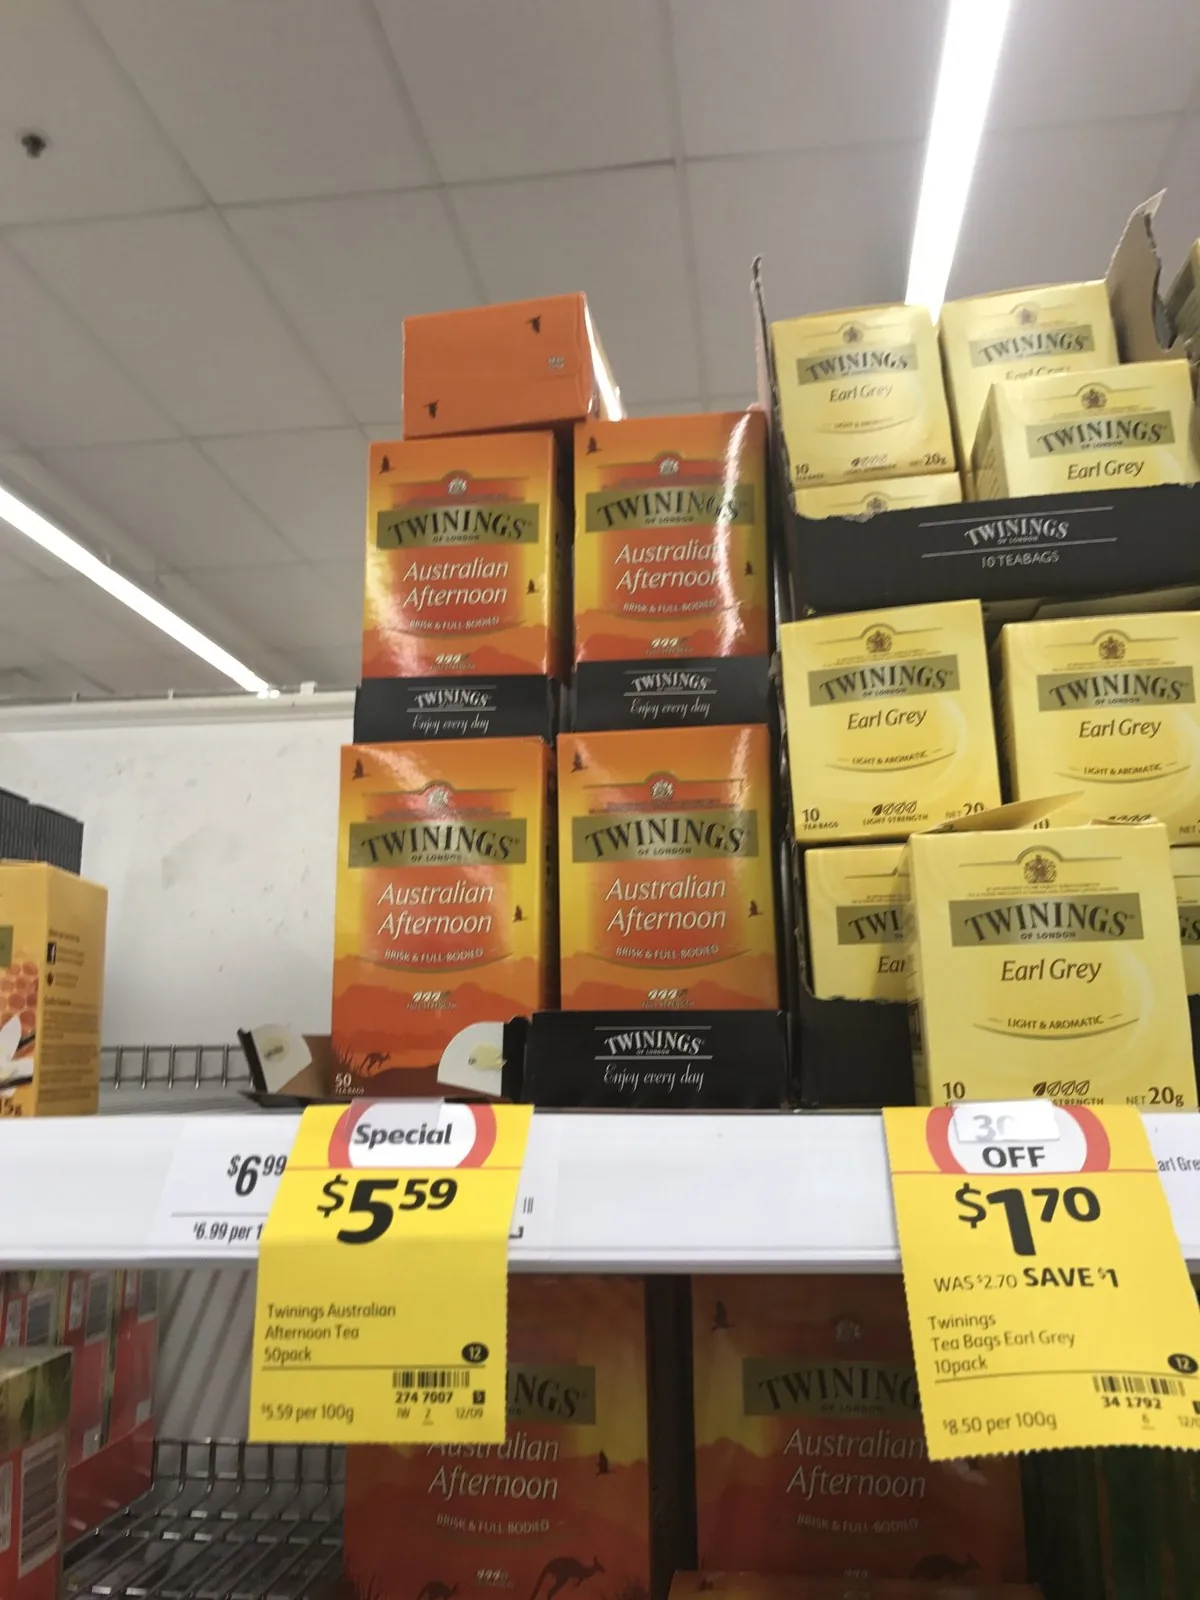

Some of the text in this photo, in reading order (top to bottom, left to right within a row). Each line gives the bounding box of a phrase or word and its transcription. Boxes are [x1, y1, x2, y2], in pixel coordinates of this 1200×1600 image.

[978, 332, 1088, 363] TWININGS
[805, 351, 909, 381] TWININGS
[829, 385, 893, 403] Earl Grey
[1036, 419, 1163, 454] TWININGS
[794, 463, 810, 477] 10
[1067, 459, 1145, 481] Earl Grey
[387, 508, 528, 545] TWININGS
[963, 517, 1070, 546] TWININGS
[403, 557, 509, 582] Australian
[402, 583, 507, 612] Afternoon
[630, 671, 711, 692] TWININGS
[819, 663, 949, 701] TWININGS
[1049, 673, 1183, 707] TWININGS
[413, 688, 491, 708] TWININGS
[630, 695, 711, 720] Enjoy every day
[412, 712, 491, 735] Enjoy every day
[847, 708, 928, 730] Earl Grey
[1078, 718, 1162, 739] Earl Grey
[852, 756, 876, 765] LIGHT
[1083, 766, 1109, 775] LIGHT
[802, 808, 820, 823] 10
[862, 817, 886, 827] LIGHT
[944, 809, 962, 819] NET
[360, 824, 515, 864] TWININGS
[585, 817, 746, 858] TWININGS
[376, 879, 494, 906] Australian
[604, 874, 727, 901] Australian
[376, 910, 493, 941] Afternoon
[606, 905, 727, 937] Afternoon
[964, 900, 1130, 942] TWININGS
[1020, 931, 1076, 940] OF LONDON
[384, 947, 411, 962] BRISK
[420, 952, 444, 964] FULL
[615, 946, 644, 958] BRISK
[653, 949, 677, 960] FULL
[1000, 957, 1103, 983] Earl Grey
[1007, 1014, 1105, 1030] LIGHT & AROMATIC
[604, 1029, 705, 1056] TWININGS
[335, 1072, 353, 1088] 50
[603, 1062, 705, 1093] Enjoy every day
[942, 1080, 966, 1100] 10
[1126, 1086, 1184, 1108] NET 20g
[353, 1123, 453, 1150] Special
[982, 1145, 1046, 1168] OFF
[193, 1221, 253, 1245] $6.99 per
[933, 1266, 1119, 1292] WAS $2.70 SAVE $1
[268, 1301, 397, 1323] Twinings Australian
[928, 1313, 996, 1331] Twinings
[264, 1323, 360, 1340] Afternoon Tea
[932, 1329, 1076, 1352] Tea Bags Earl Grey
[264, 1346, 312, 1367] 50pack
[934, 1353, 988, 1377] 10pack
[1174, 1356, 1193, 1372] 12
[395, 1390, 418, 1404] 274
[1101, 1396, 1162, 1410] 34 1792
[261, 1403, 355, 1425] $5.59 per 100g
[943, 1410, 1058, 1436] $8.50 per 100g
[783, 1427, 925, 1461] Australian
[427, 1465, 559, 1502] Afternoon
[786, 1464, 926, 1501] Afternoon
[436, 1511, 466, 1532] BRISK
[478, 1519, 503, 1535] FULL
